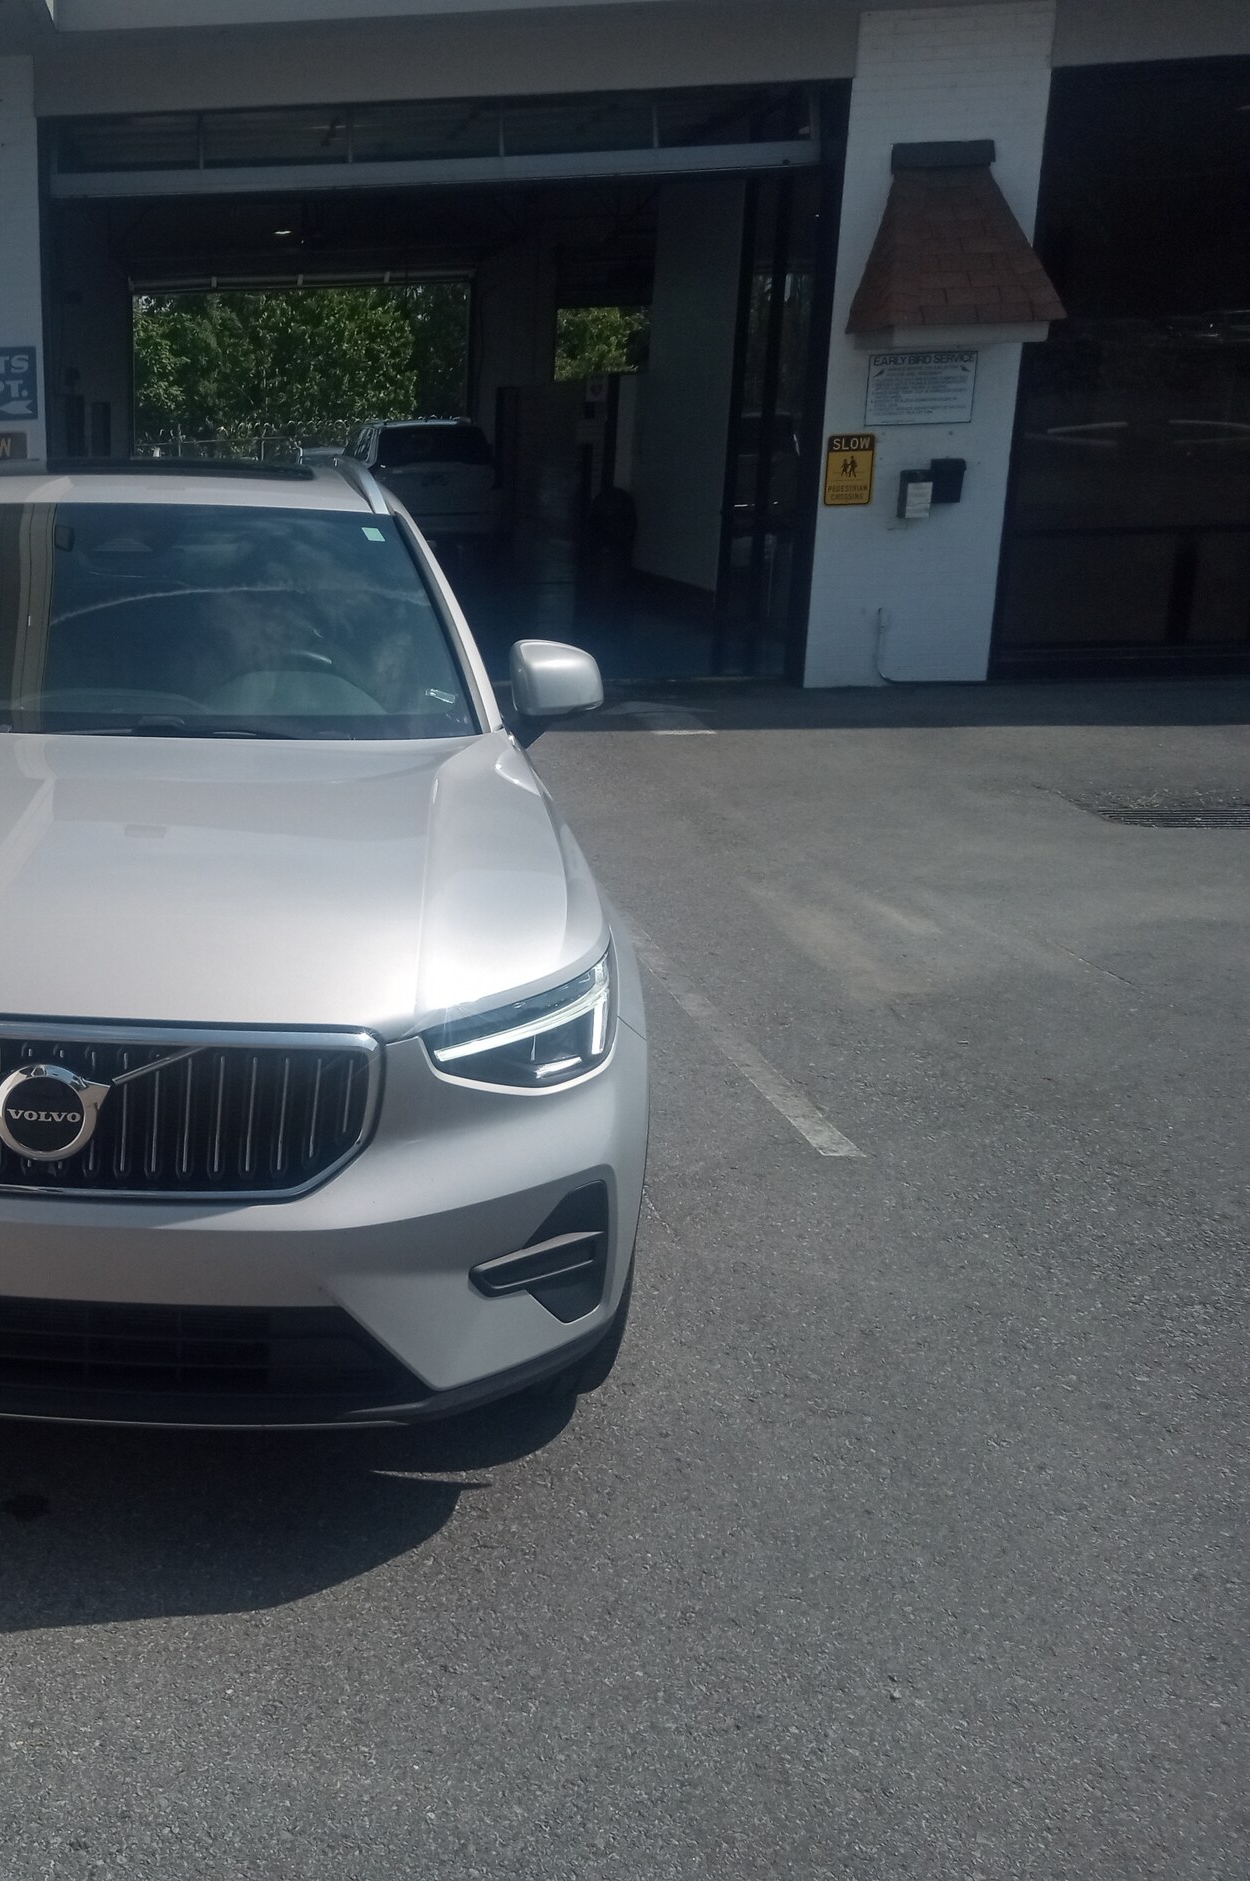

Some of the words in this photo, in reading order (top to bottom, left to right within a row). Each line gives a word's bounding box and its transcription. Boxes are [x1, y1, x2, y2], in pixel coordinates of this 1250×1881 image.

[873, 355, 908, 366] EARLY
[908, 354, 931, 365] BIRD
[934, 353, 974, 364] SERVICE
[833, 437, 870, 450] SLOW
[828, 484, 868, 492] PEDESTRIAN
[7, 1108, 81, 1123] VOLVO
